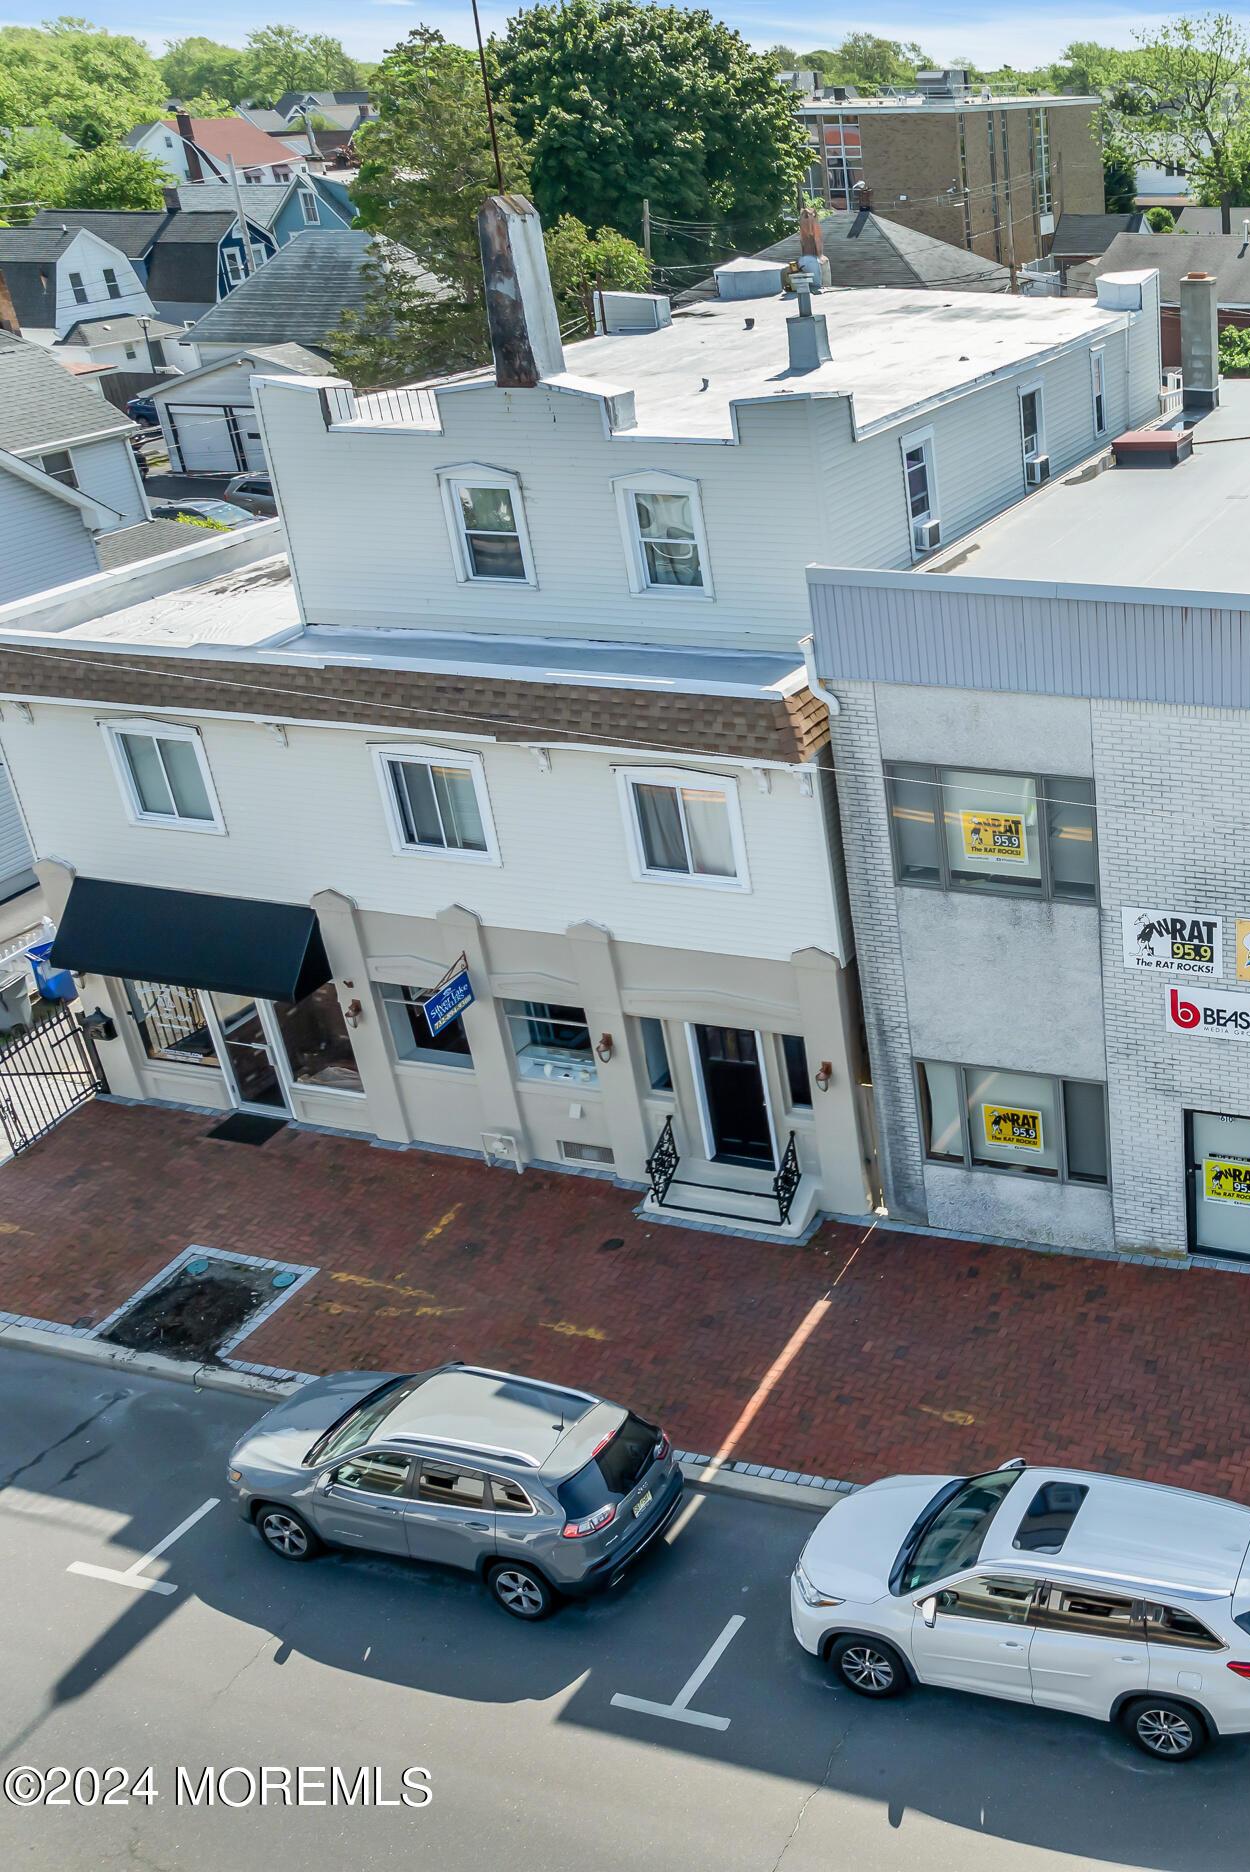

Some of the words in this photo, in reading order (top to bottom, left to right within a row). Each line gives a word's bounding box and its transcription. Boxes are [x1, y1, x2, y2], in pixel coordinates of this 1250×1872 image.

[994, 835, 1019, 847] 95.9
[1172, 943, 1211, 961] 95.9
[1136, 958, 1153, 967] The
[1155, 960, 1175, 969] RAT
[1177, 962, 1214, 973] ROCKS!
[430, 996, 451, 1019] Silver
[451, 983, 468, 1001] Lake
[1203, 1026, 1229, 1034] MEDIA
[1013, 1127, 1036, 1139] 95.9
